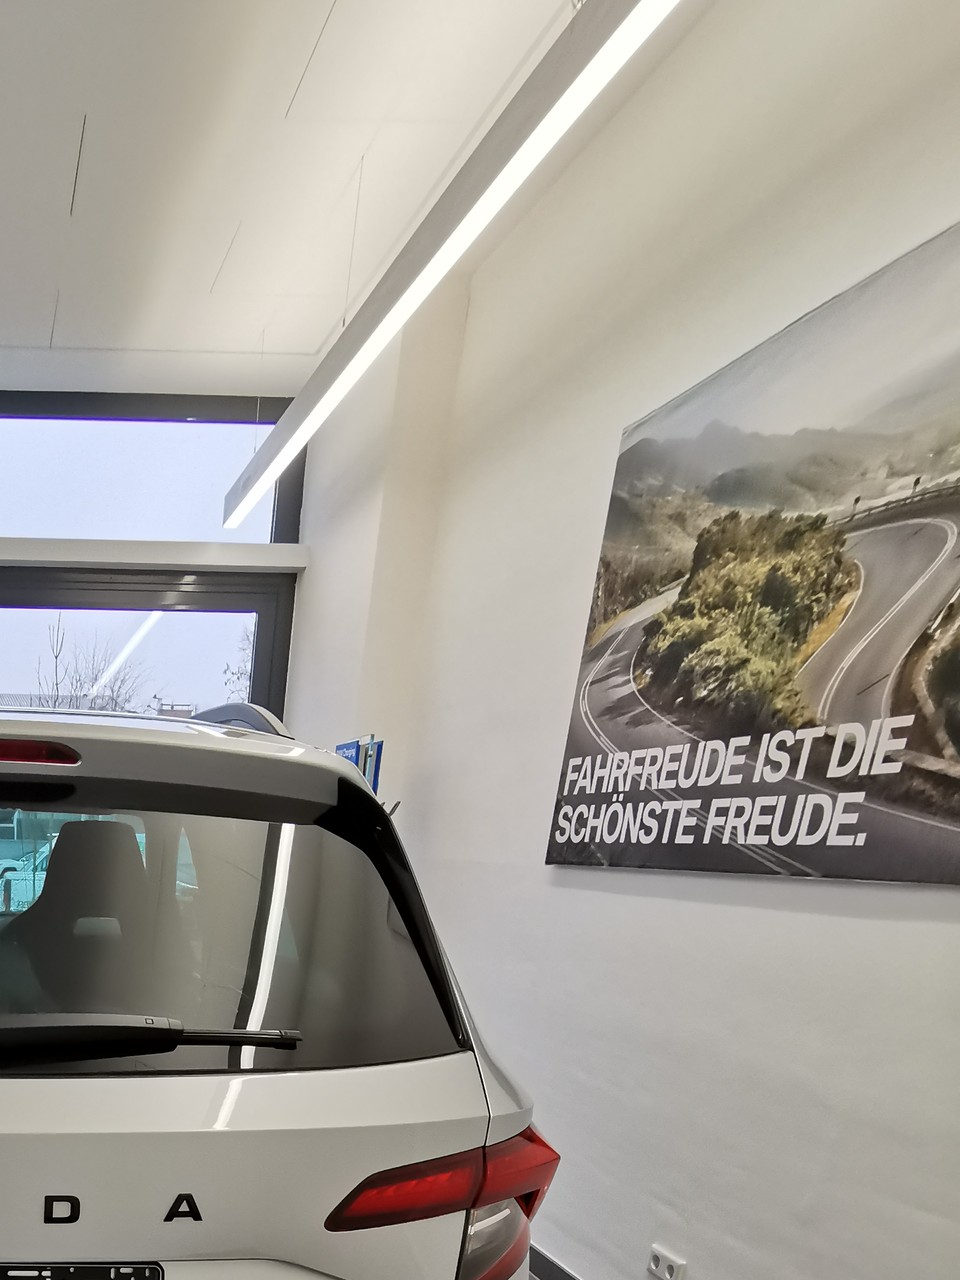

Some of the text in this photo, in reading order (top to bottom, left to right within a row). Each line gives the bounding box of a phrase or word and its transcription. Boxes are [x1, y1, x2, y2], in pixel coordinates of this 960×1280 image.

[563, 714, 916, 796] FAHRFREUDE IST DIE
[554, 791, 866, 846] SCHÖNSTE FREUDE.
